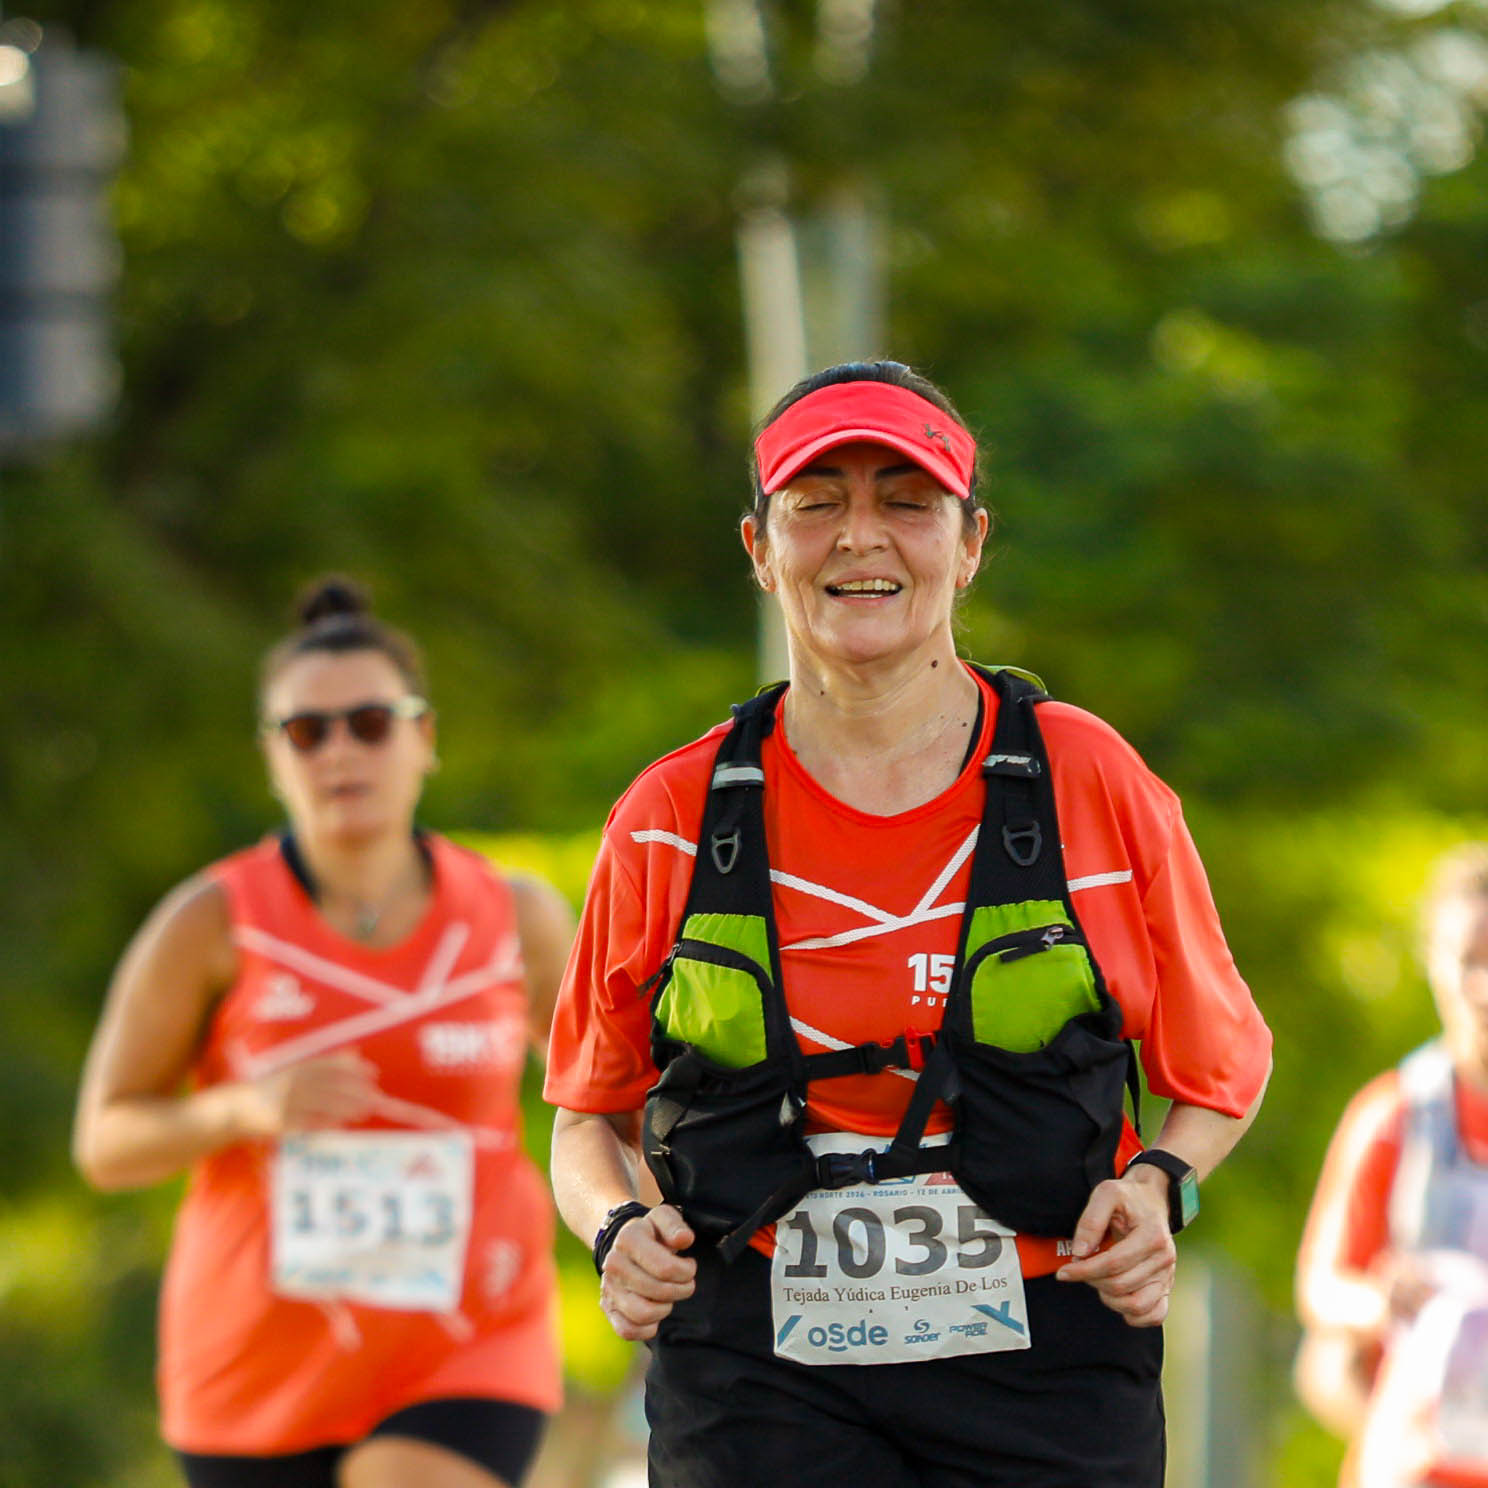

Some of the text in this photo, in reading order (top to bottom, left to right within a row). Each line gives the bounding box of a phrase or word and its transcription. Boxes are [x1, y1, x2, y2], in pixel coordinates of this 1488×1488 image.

[873, 1187, 909, 1197] ROSARIO
[289, 1189, 456, 1246] 1513
[783, 1205, 1003, 1279] 1035
[783, 1276, 1008, 1305] Tejada Yúdica Eugenia De Los
[807, 1319, 889, 1349] osde
